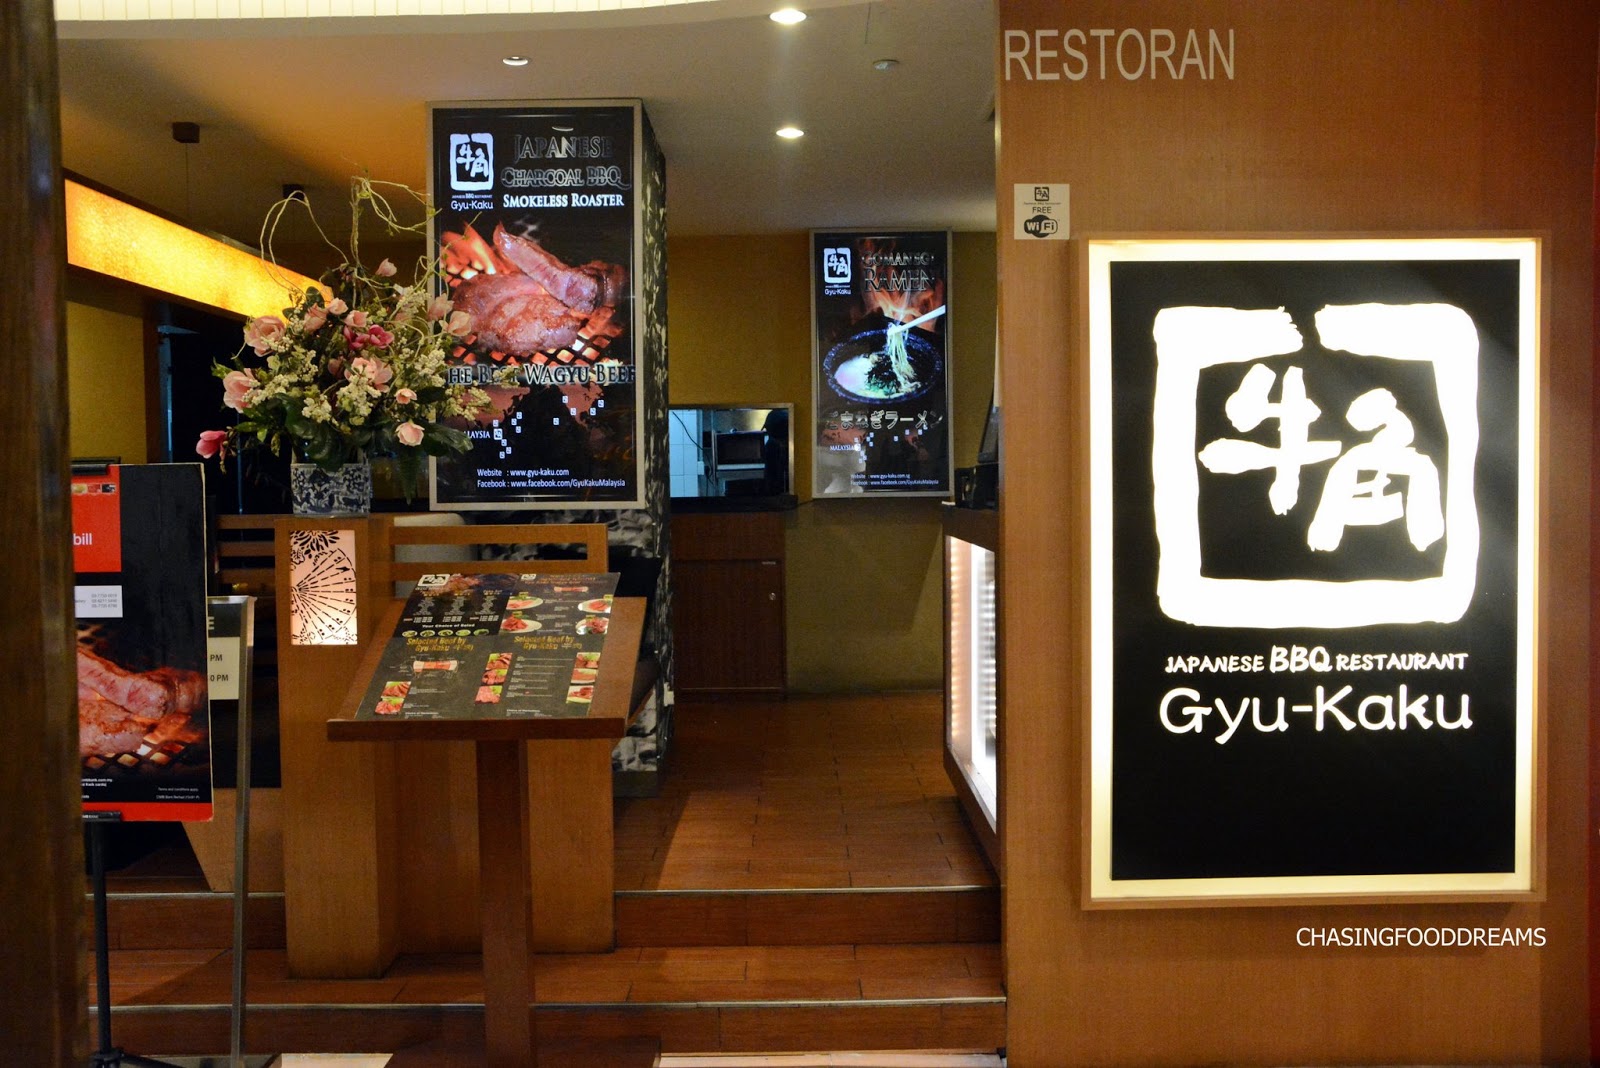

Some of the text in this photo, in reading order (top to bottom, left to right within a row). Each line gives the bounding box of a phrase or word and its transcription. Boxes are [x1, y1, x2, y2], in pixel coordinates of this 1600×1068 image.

[1004, 28, 1235, 81] RESTORAN
[514, 134, 613, 164] JAPANESE
[501, 165, 632, 190] CHARCOAL BBQ
[450, 200, 494, 211] Gyu-Kaku
[503, 193, 625, 208] SMOKELESS ROASTER
[1032, 206, 1052, 214] FREE
[864, 267, 935, 292] RAMEN
[447, 366, 473, 385] HE
[523, 363, 590, 385] WAGYU
[824, 410, 945, 430] ごまねぎラーメン
[463, 430, 490, 439] LAYSIA
[1198, 362, 1445, 553] 牛角
[477, 468, 502, 477] Website
[510, 467, 570, 478] www.gyu-kaku.com
[477, 480, 506, 488] Facebook
[511, 478, 626, 488] www.facebook.com/GyuKakuMalaysia
[73, 533, 93, 546] bill
[1164, 644, 1469, 674] JAPANESE BBQ RESTAURANT
[216, 674, 229, 682] PM
[1159, 684, 1473, 745] Gyu-Kaku
